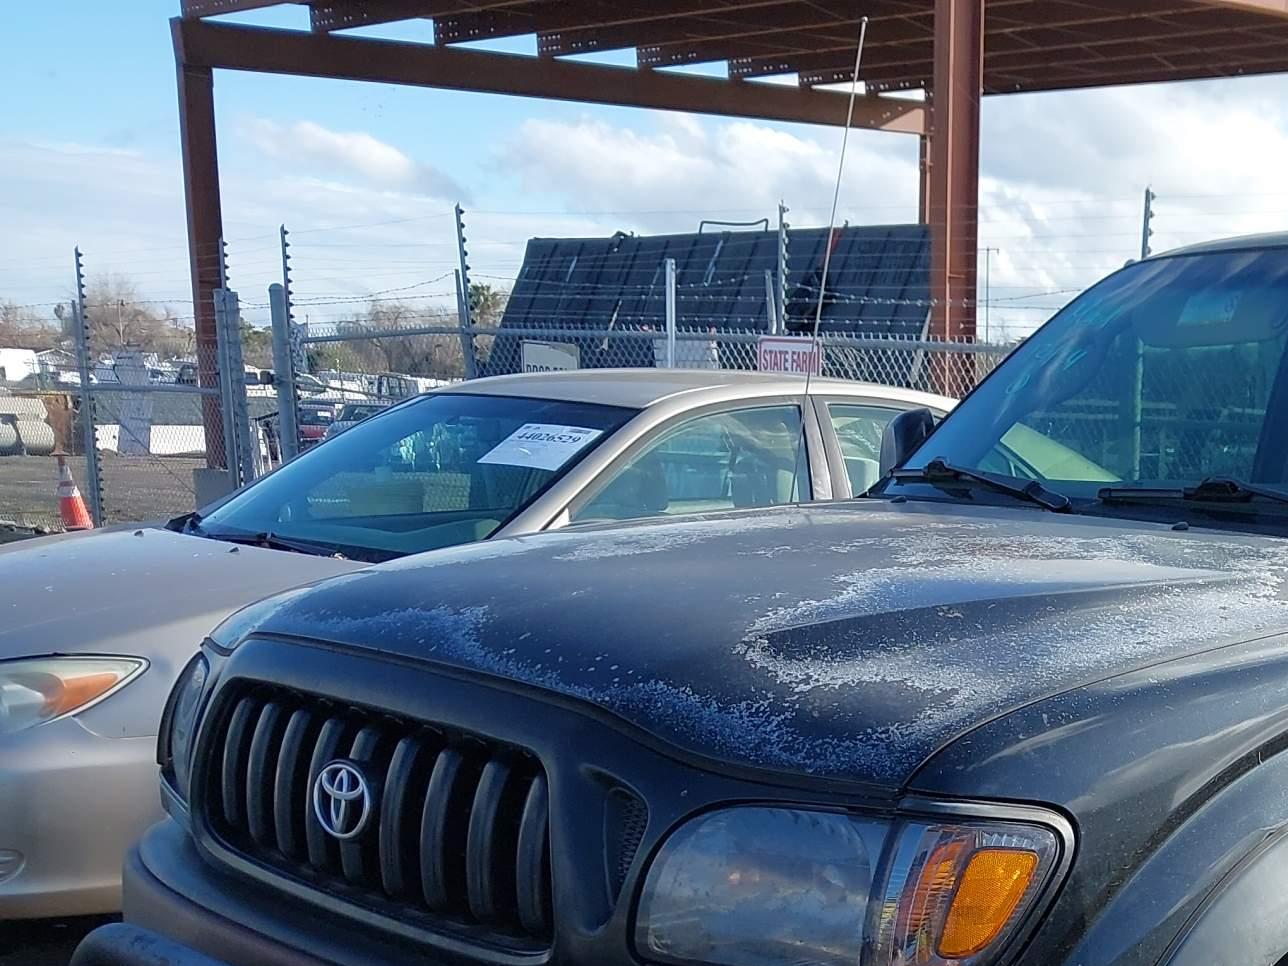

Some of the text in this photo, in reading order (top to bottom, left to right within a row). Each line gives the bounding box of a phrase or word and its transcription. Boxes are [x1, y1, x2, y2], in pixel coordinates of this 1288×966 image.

[762, 349, 816, 373] STATE FARM
[516, 431, 582, 444] 44026529
